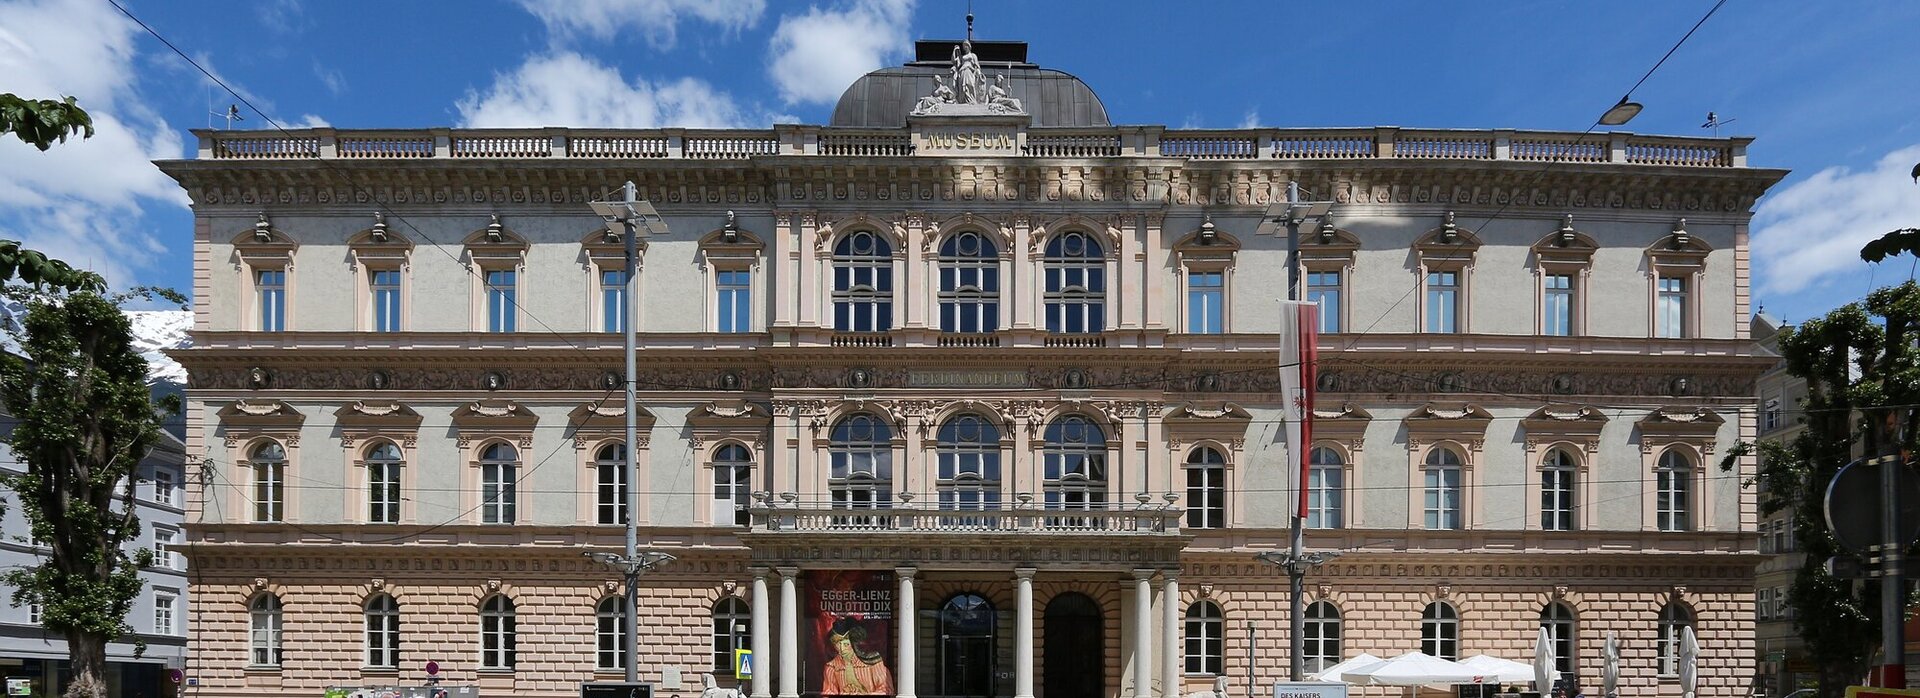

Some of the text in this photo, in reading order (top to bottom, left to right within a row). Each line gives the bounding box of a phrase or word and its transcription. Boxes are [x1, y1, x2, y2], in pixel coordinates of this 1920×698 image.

[926, 132, 1012, 149] MUSEUM
[911, 372, 1026, 385] FERDINANDEUM
[821, 590, 891, 600] EGGER-LIENZ
[820, 601, 891, 611] UND OTTO DIX
